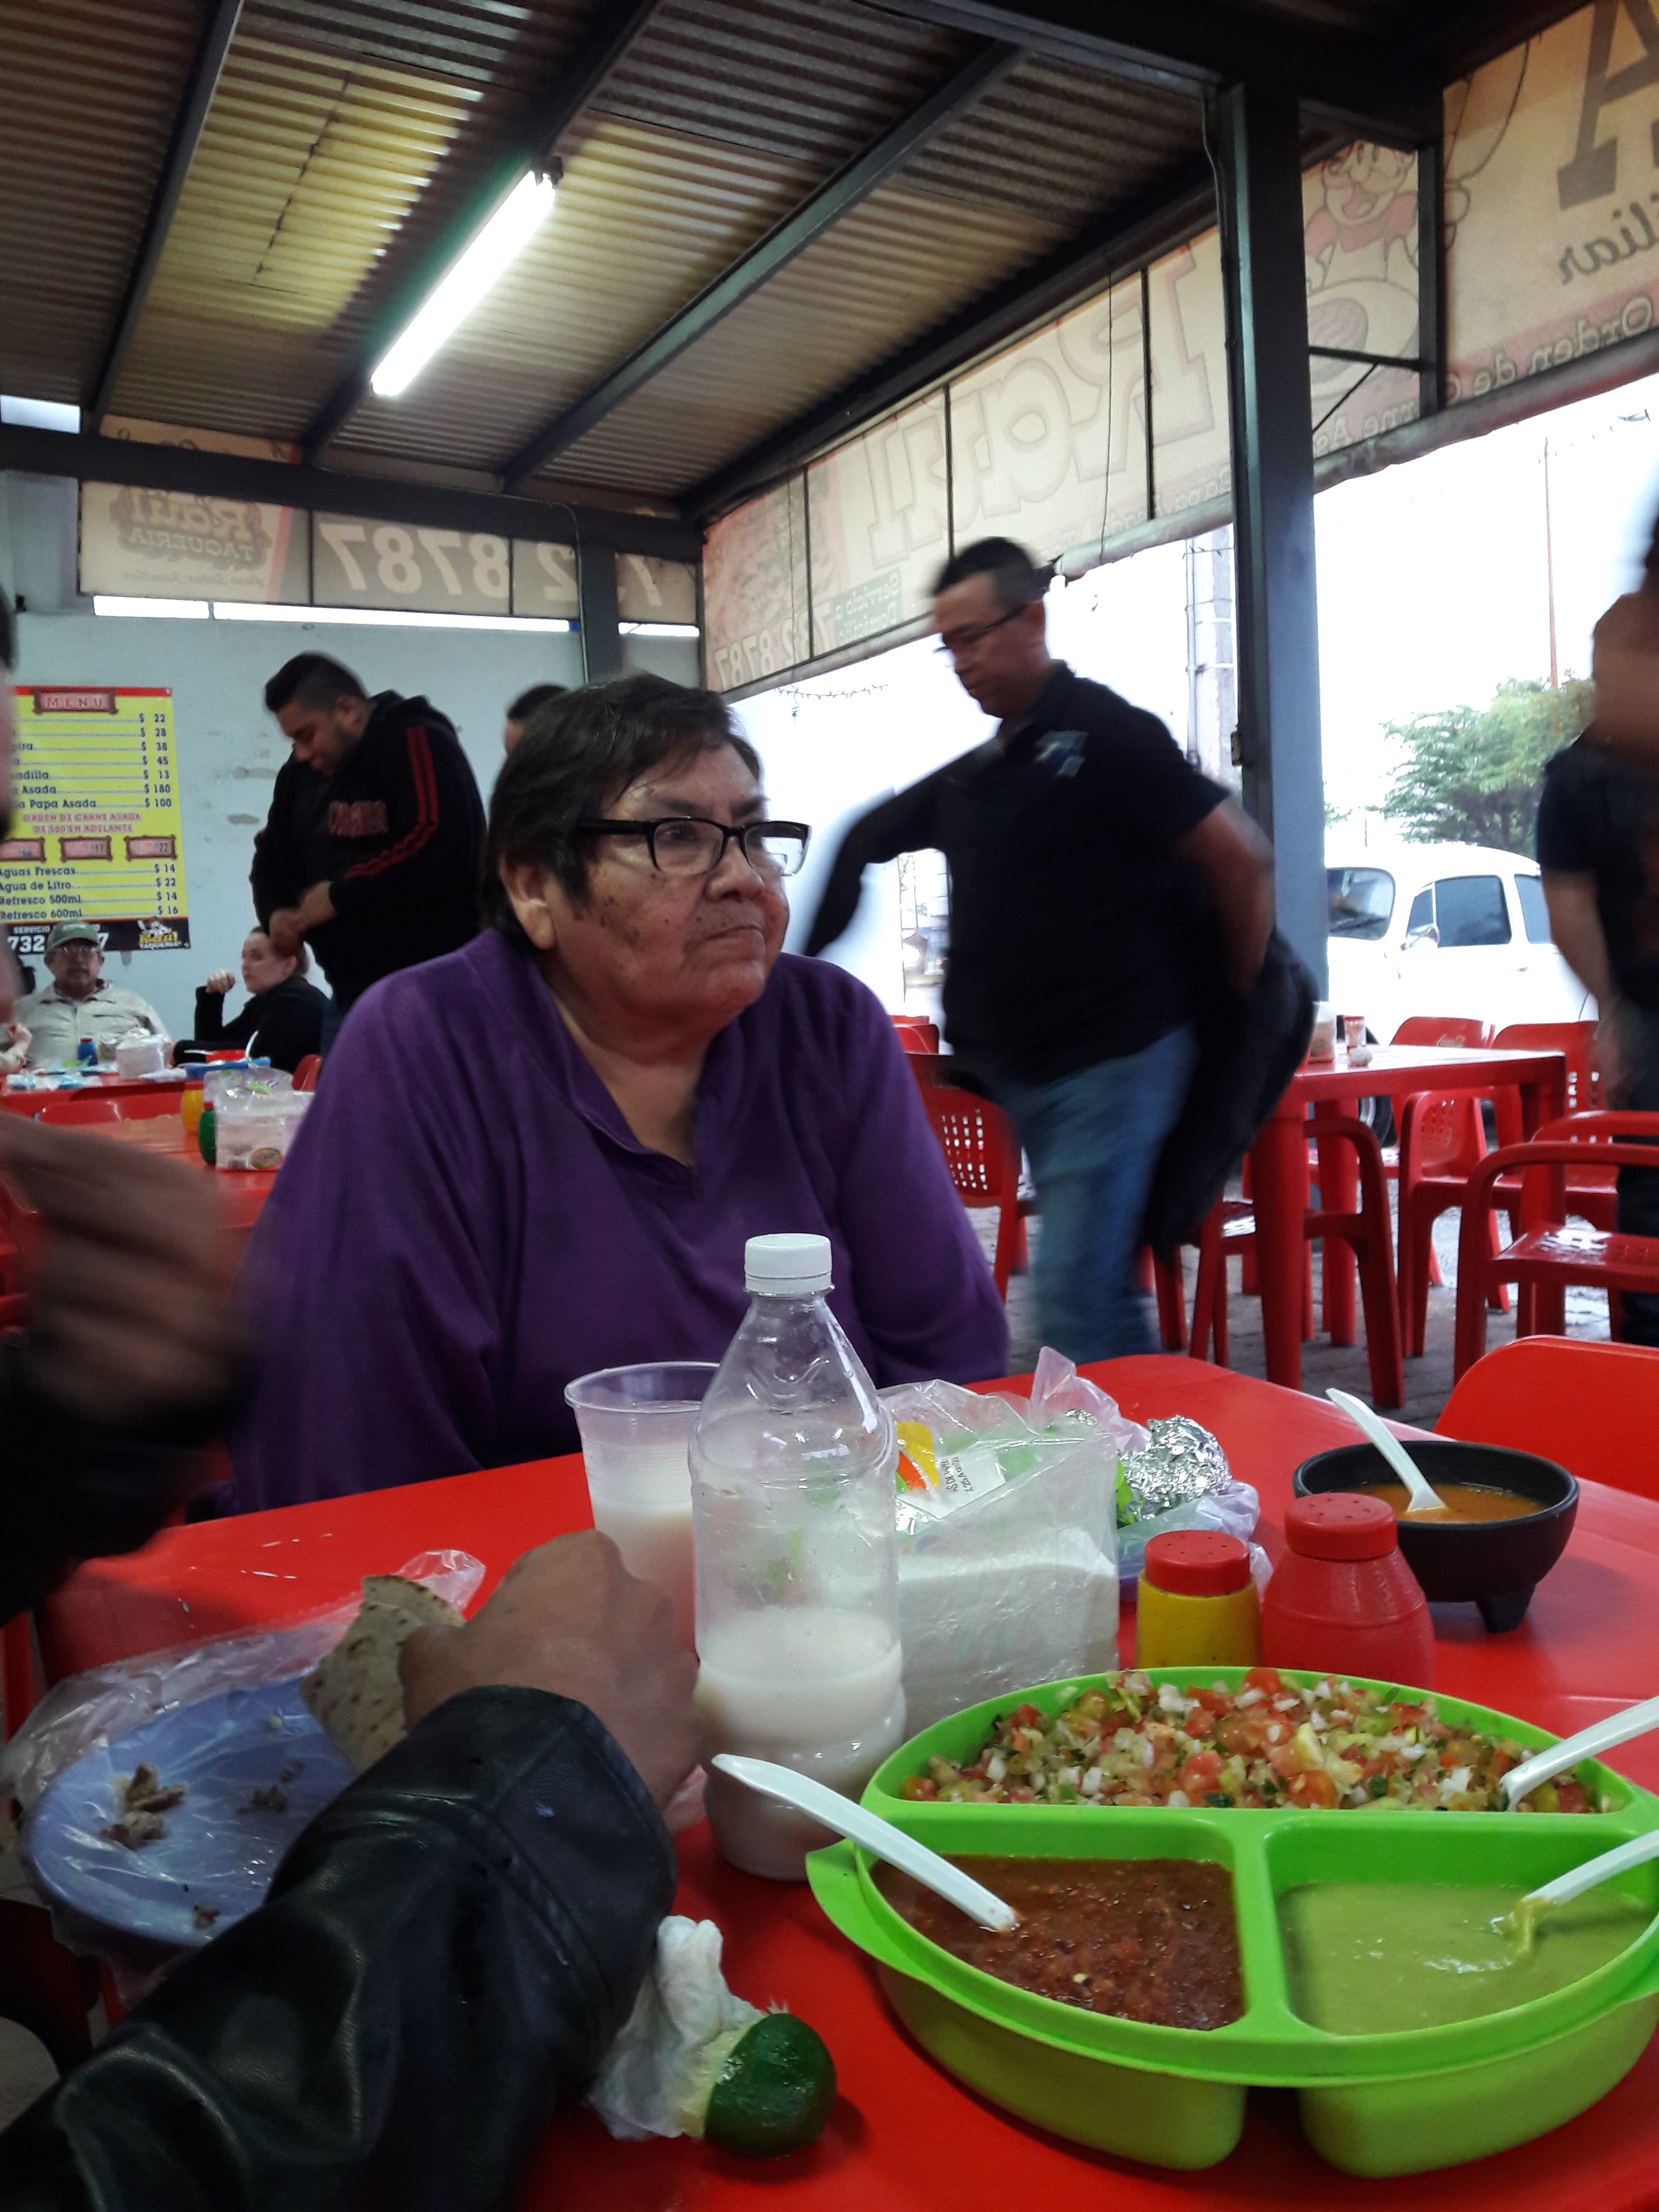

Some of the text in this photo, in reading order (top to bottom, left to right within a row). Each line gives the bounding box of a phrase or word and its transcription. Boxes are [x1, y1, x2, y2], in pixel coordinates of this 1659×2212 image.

[46, 697, 102, 707] MENU
[154, 713, 165, 723] 22
[22, 785, 56, 794] Asada
[29, 800, 58, 810] Papa
[62, 798, 97, 808] Asada
[154, 798, 171, 808] 100
[164, 864, 175, 873] 14
[49, 894, 81, 904] 500ml
[50, 909, 82, 919] 600ml
[168, 905, 178, 915] 16
[7, 934, 46, 954] 732
